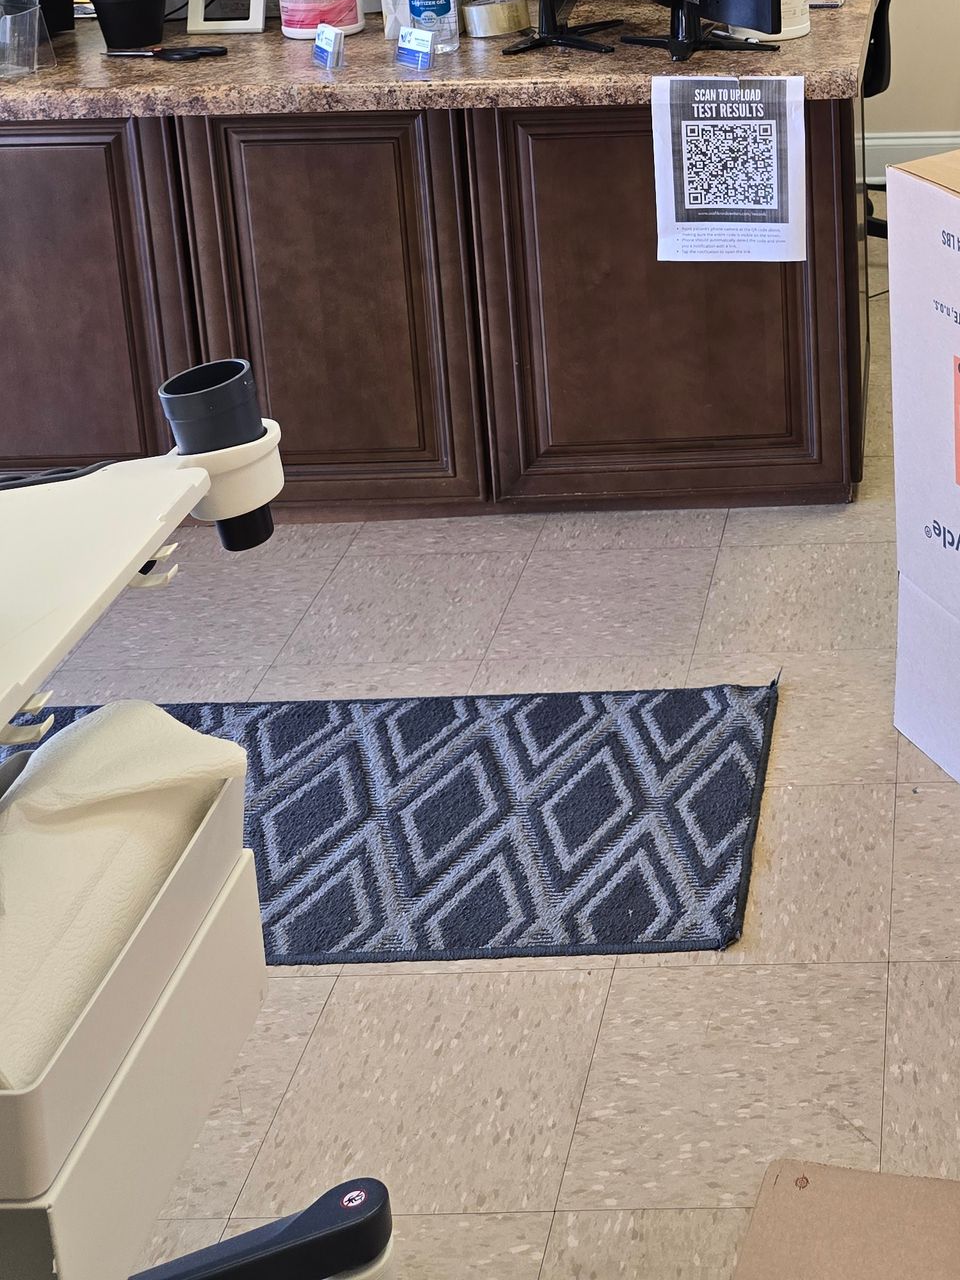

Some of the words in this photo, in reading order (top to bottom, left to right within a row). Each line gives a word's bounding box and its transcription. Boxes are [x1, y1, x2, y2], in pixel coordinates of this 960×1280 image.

[694, 88, 716, 101] SCAN
[717, 88, 728, 101] TO
[730, 88, 761, 101] UPLOAD
[691, 103, 718, 118] TEST
[720, 103, 764, 118] RESULTS
[941, 229, 955, 250] LBS
